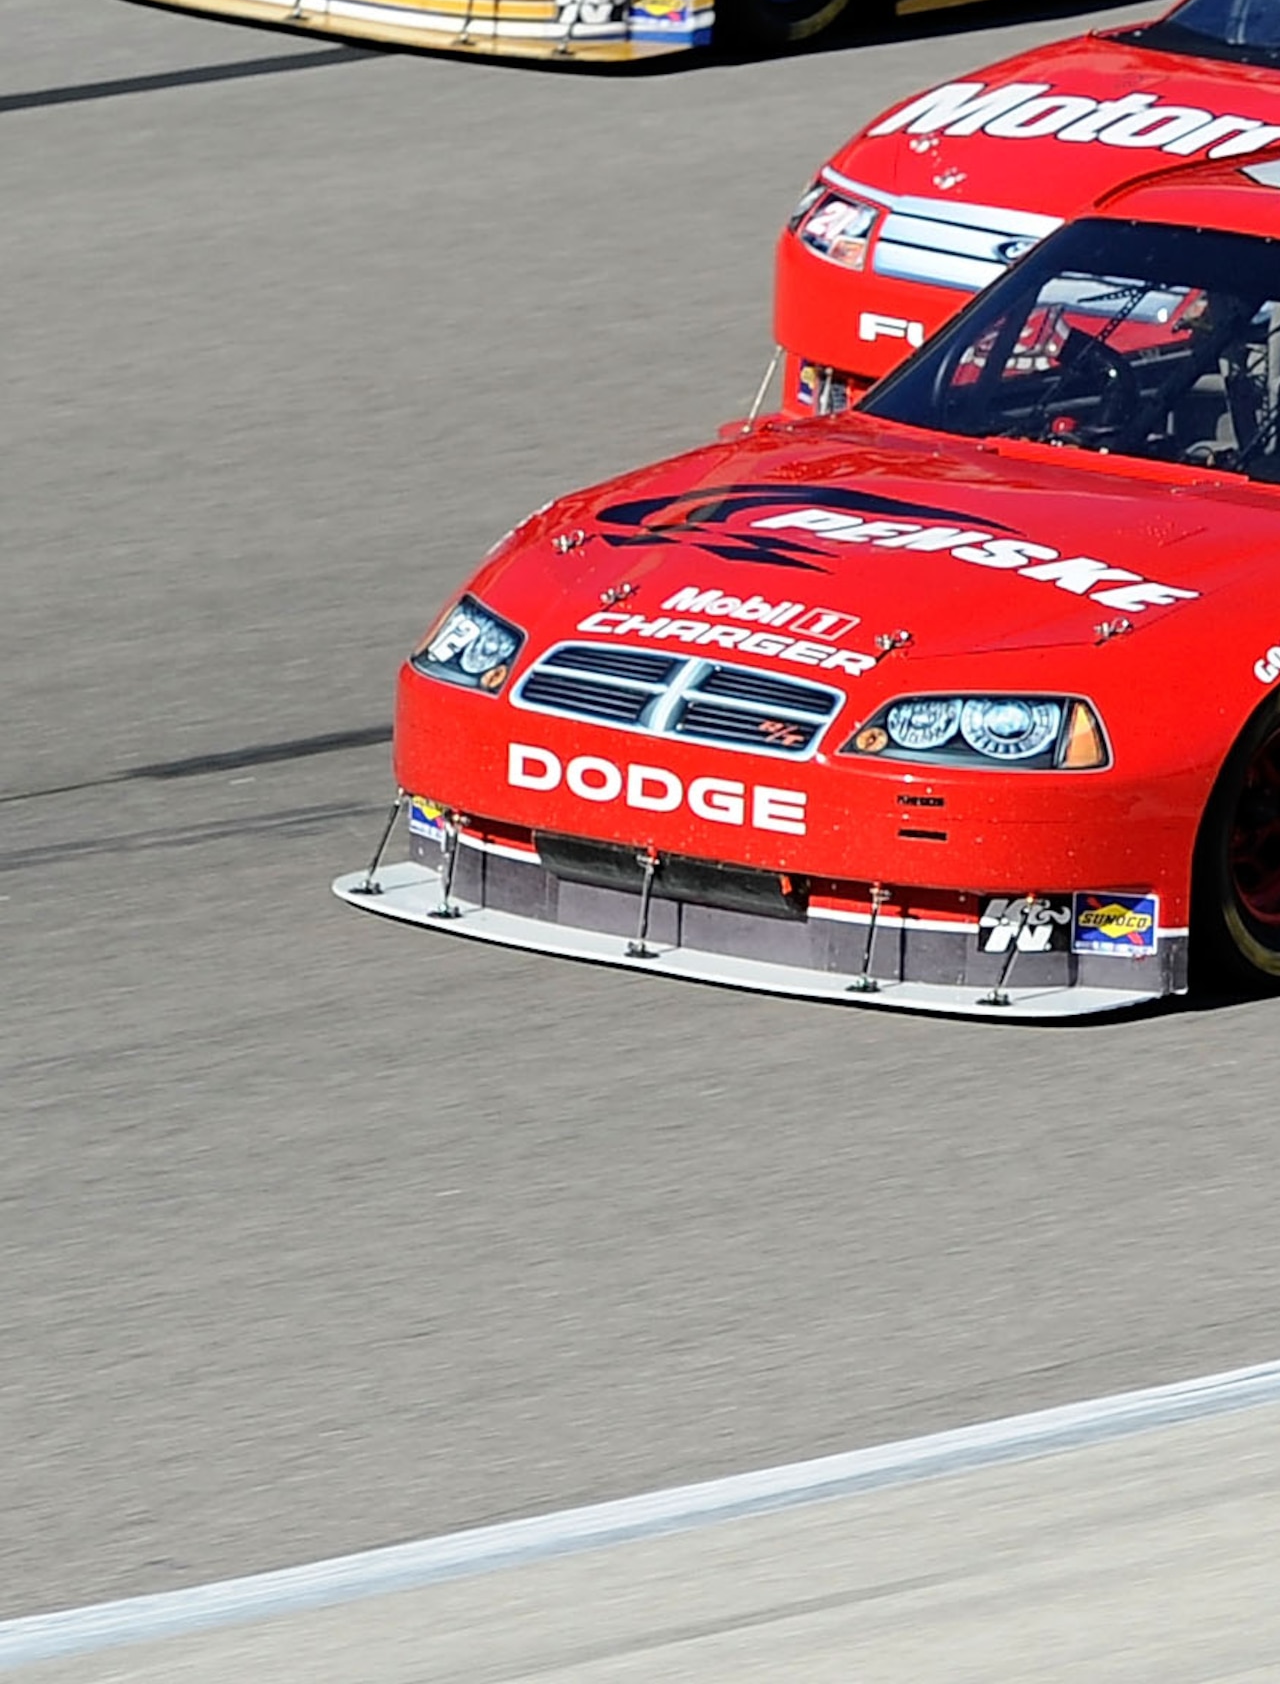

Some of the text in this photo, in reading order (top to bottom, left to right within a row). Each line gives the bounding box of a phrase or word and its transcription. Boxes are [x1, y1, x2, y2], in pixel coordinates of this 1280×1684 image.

[749, 508, 1200, 613] PENSKE
[662, 585, 805, 626] Mobil
[577, 610, 879, 677] CHARGER
[507, 741, 808, 836] DODGE
[1080, 912, 1149, 928] SUNOCO
